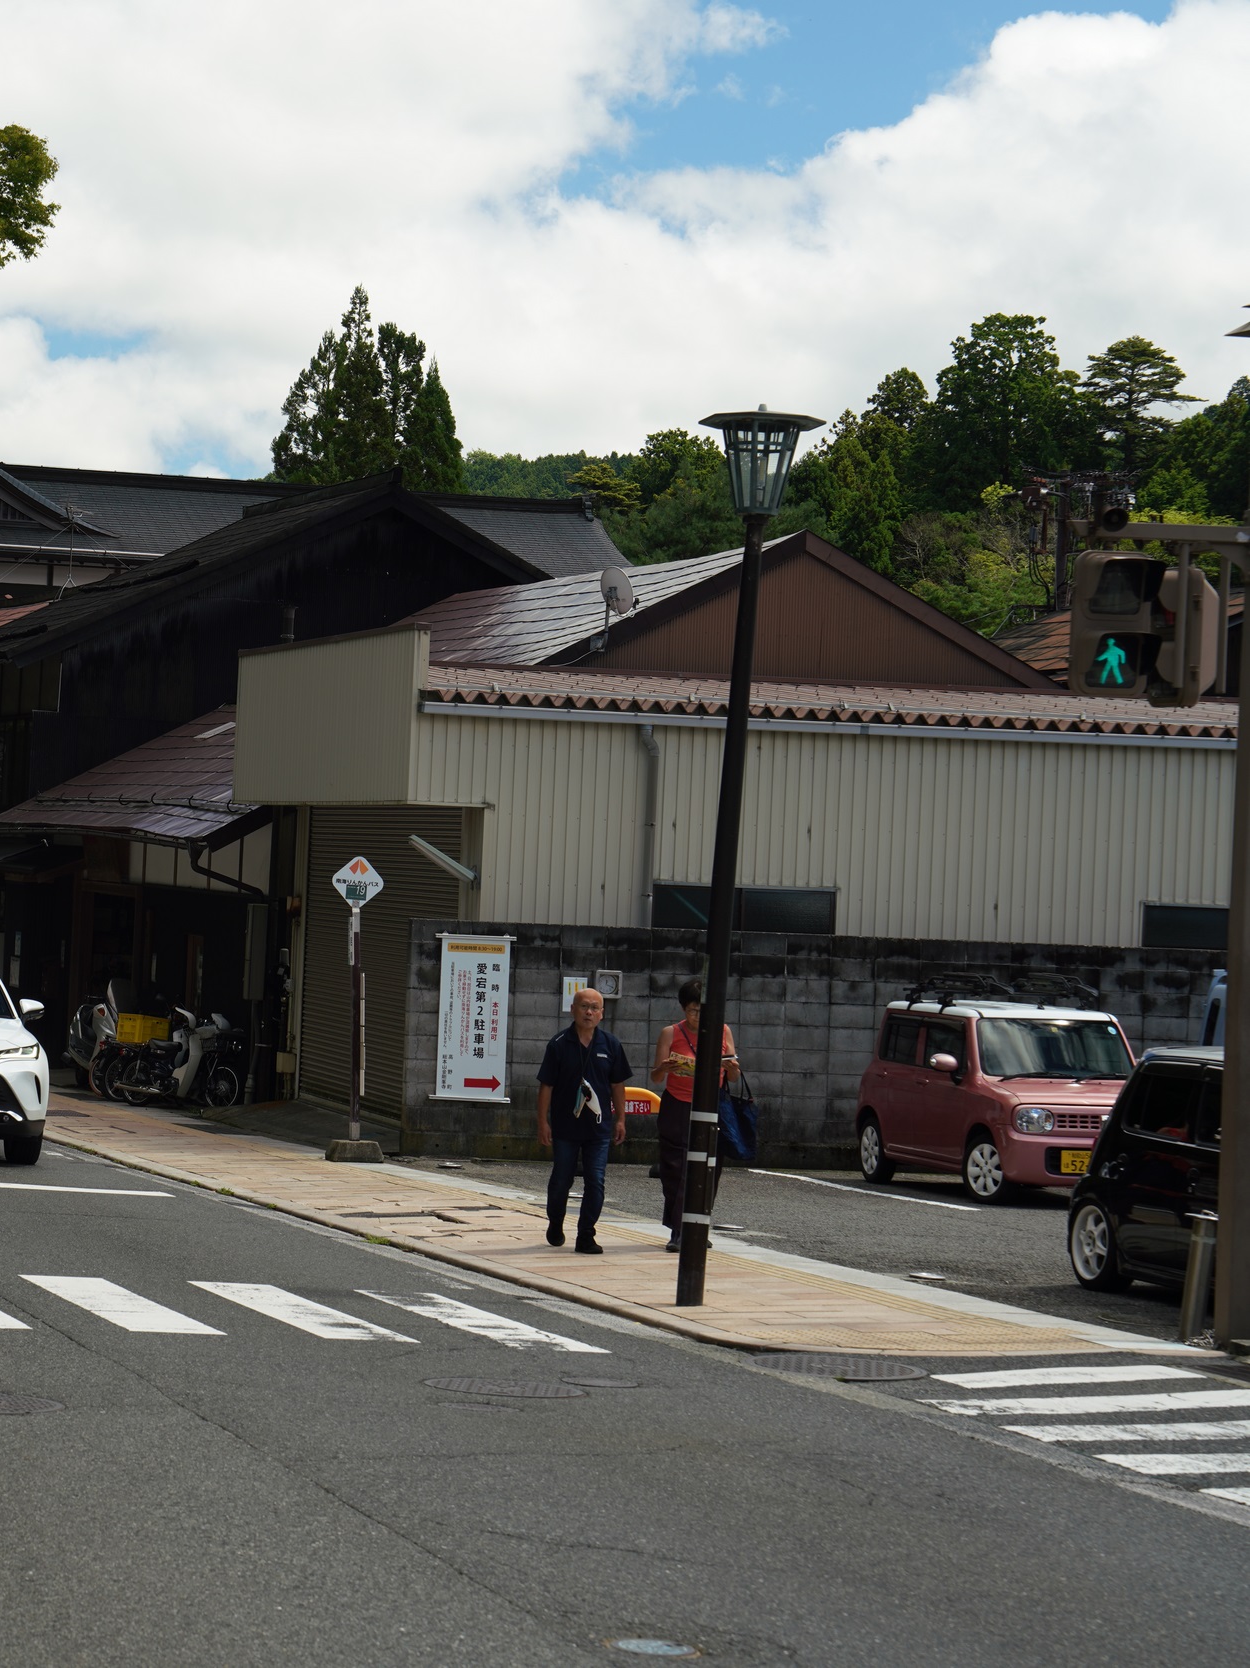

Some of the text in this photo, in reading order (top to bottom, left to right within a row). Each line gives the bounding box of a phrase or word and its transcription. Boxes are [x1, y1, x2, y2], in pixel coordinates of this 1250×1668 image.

[335, 878, 379, 887] 南海りんかんバス
[356, 886, 366, 895] 19
[491, 963, 501, 992] 臨時
[473, 962, 487, 1059] 愛宕第2駐車場
